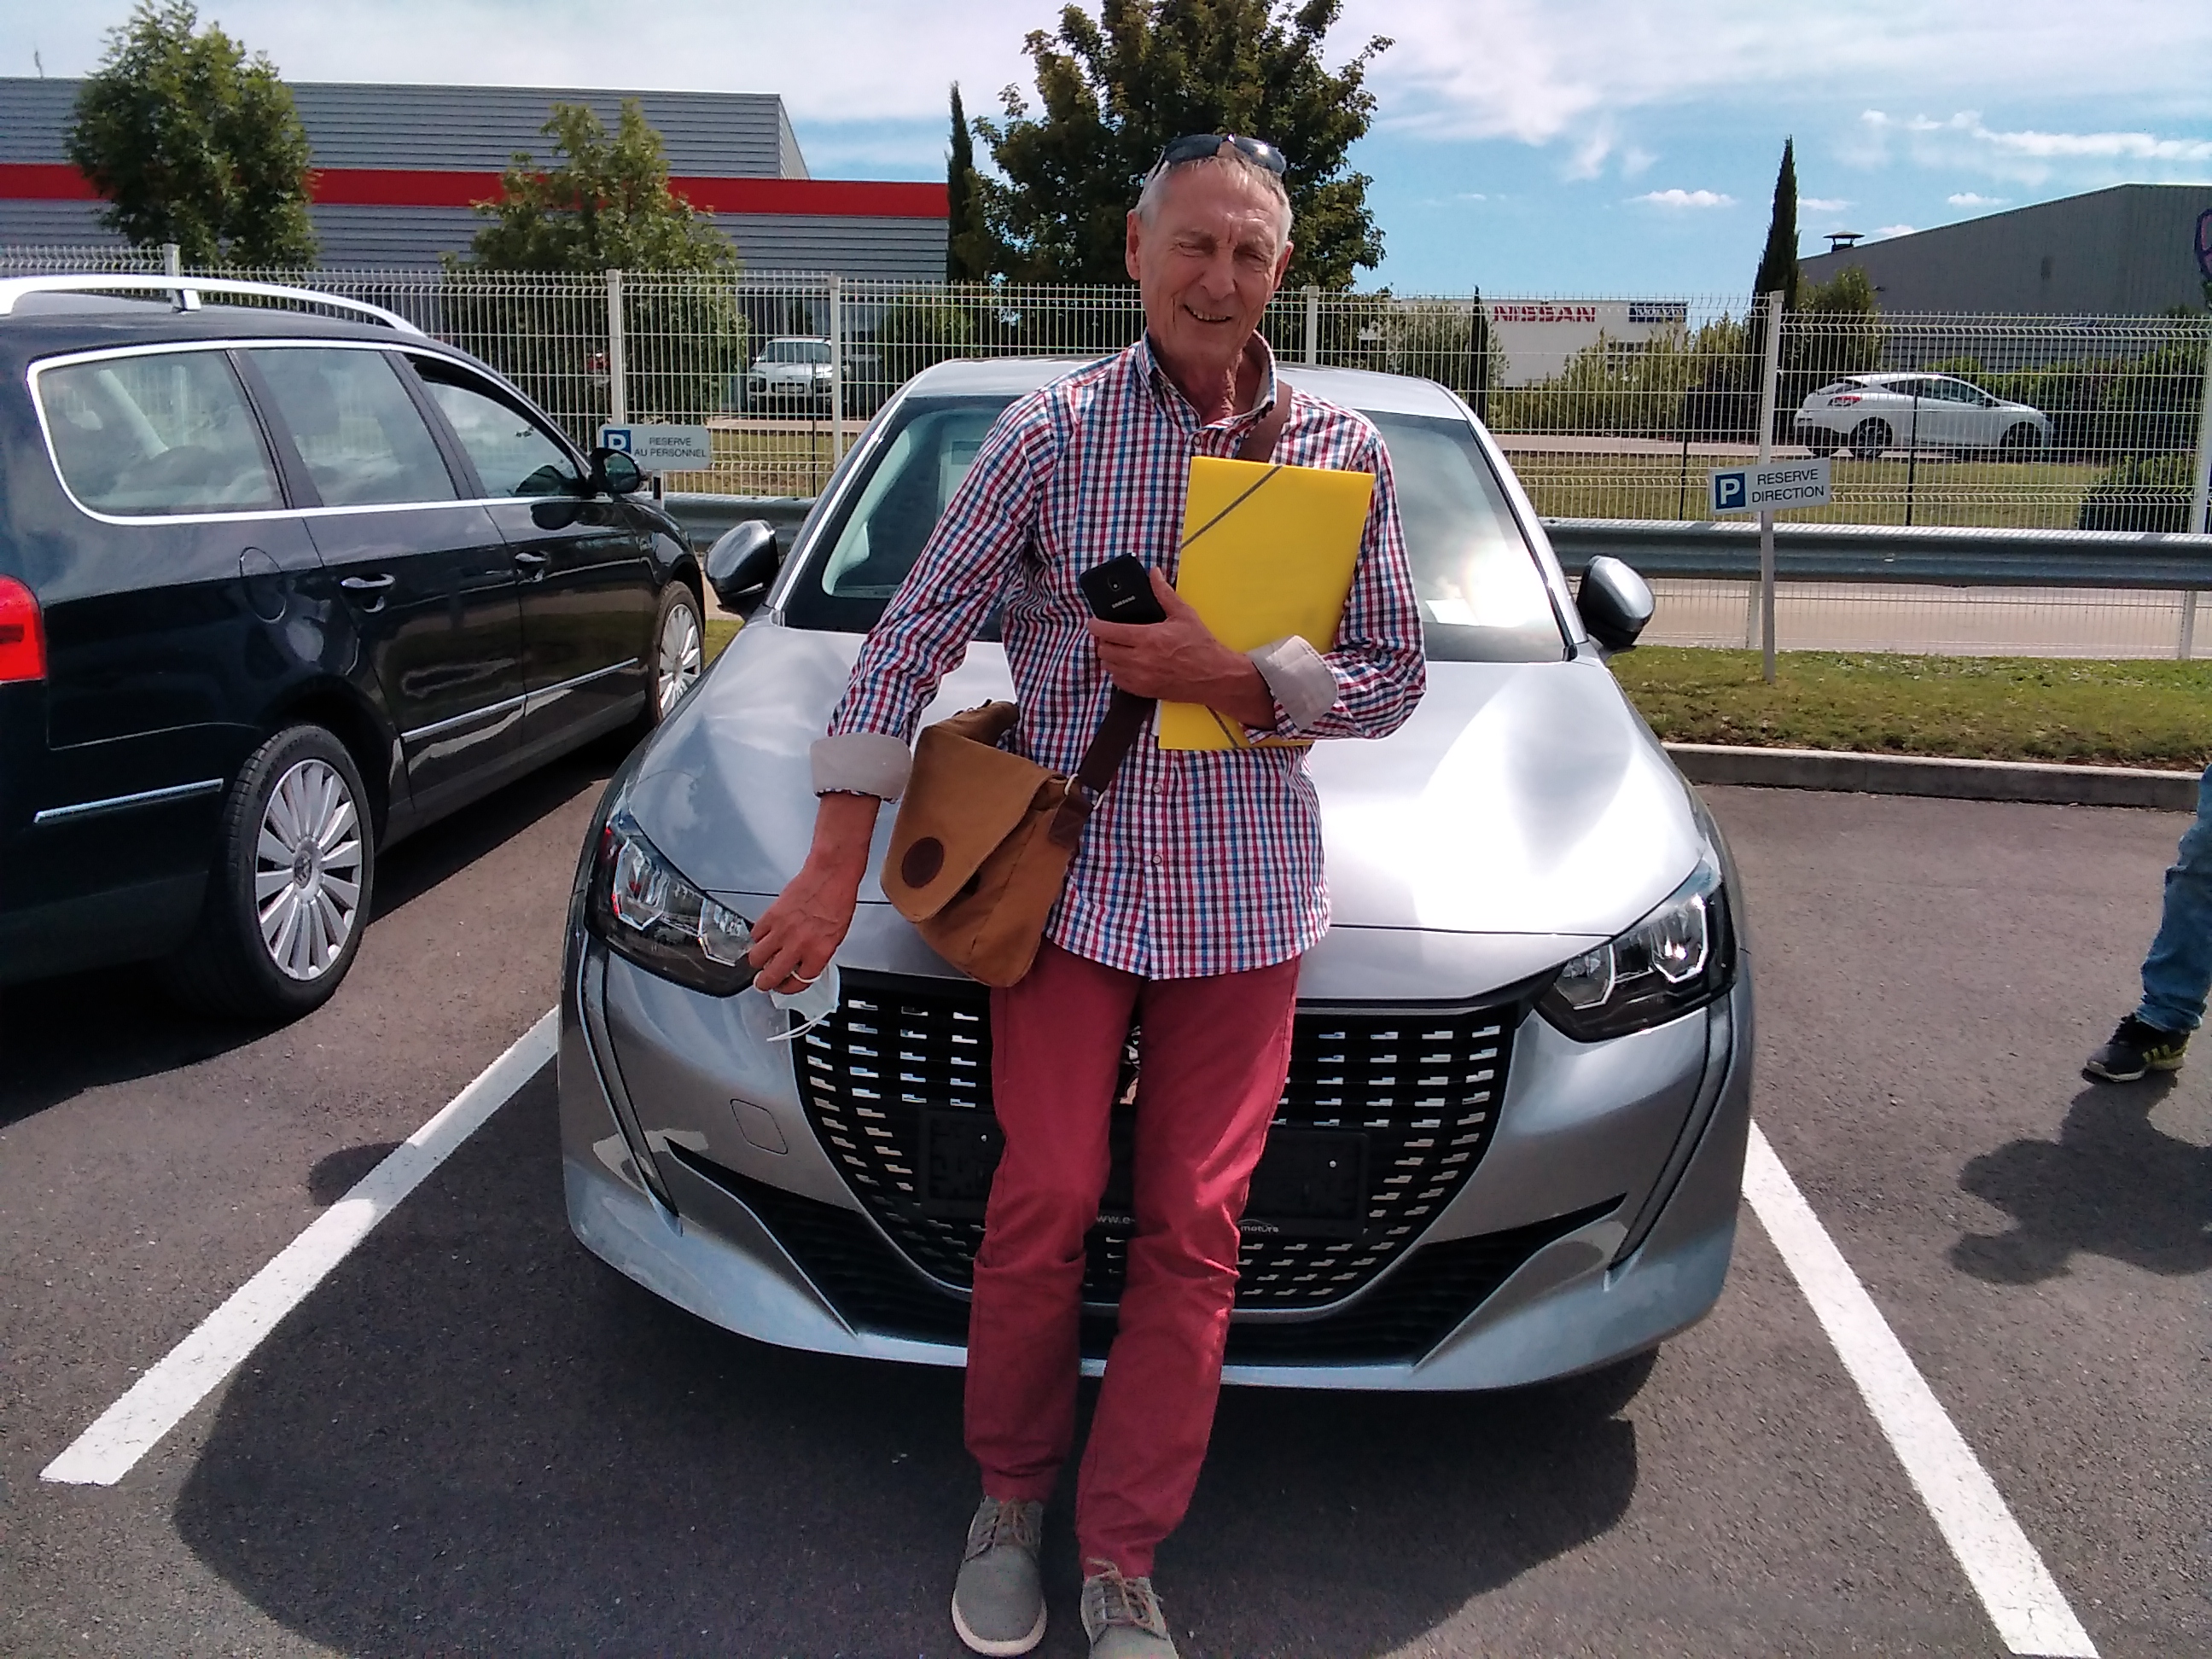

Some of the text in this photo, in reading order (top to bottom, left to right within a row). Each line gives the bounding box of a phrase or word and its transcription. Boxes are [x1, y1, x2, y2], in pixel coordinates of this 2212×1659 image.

[1493, 306, 1596, 323] NISSAN
[634, 448, 707, 457] AU PERSONNEL
[1756, 469, 1819, 486] RESERVE
[1720, 478, 1741, 505] P
[1751, 486, 1825, 503] DIRECTION
